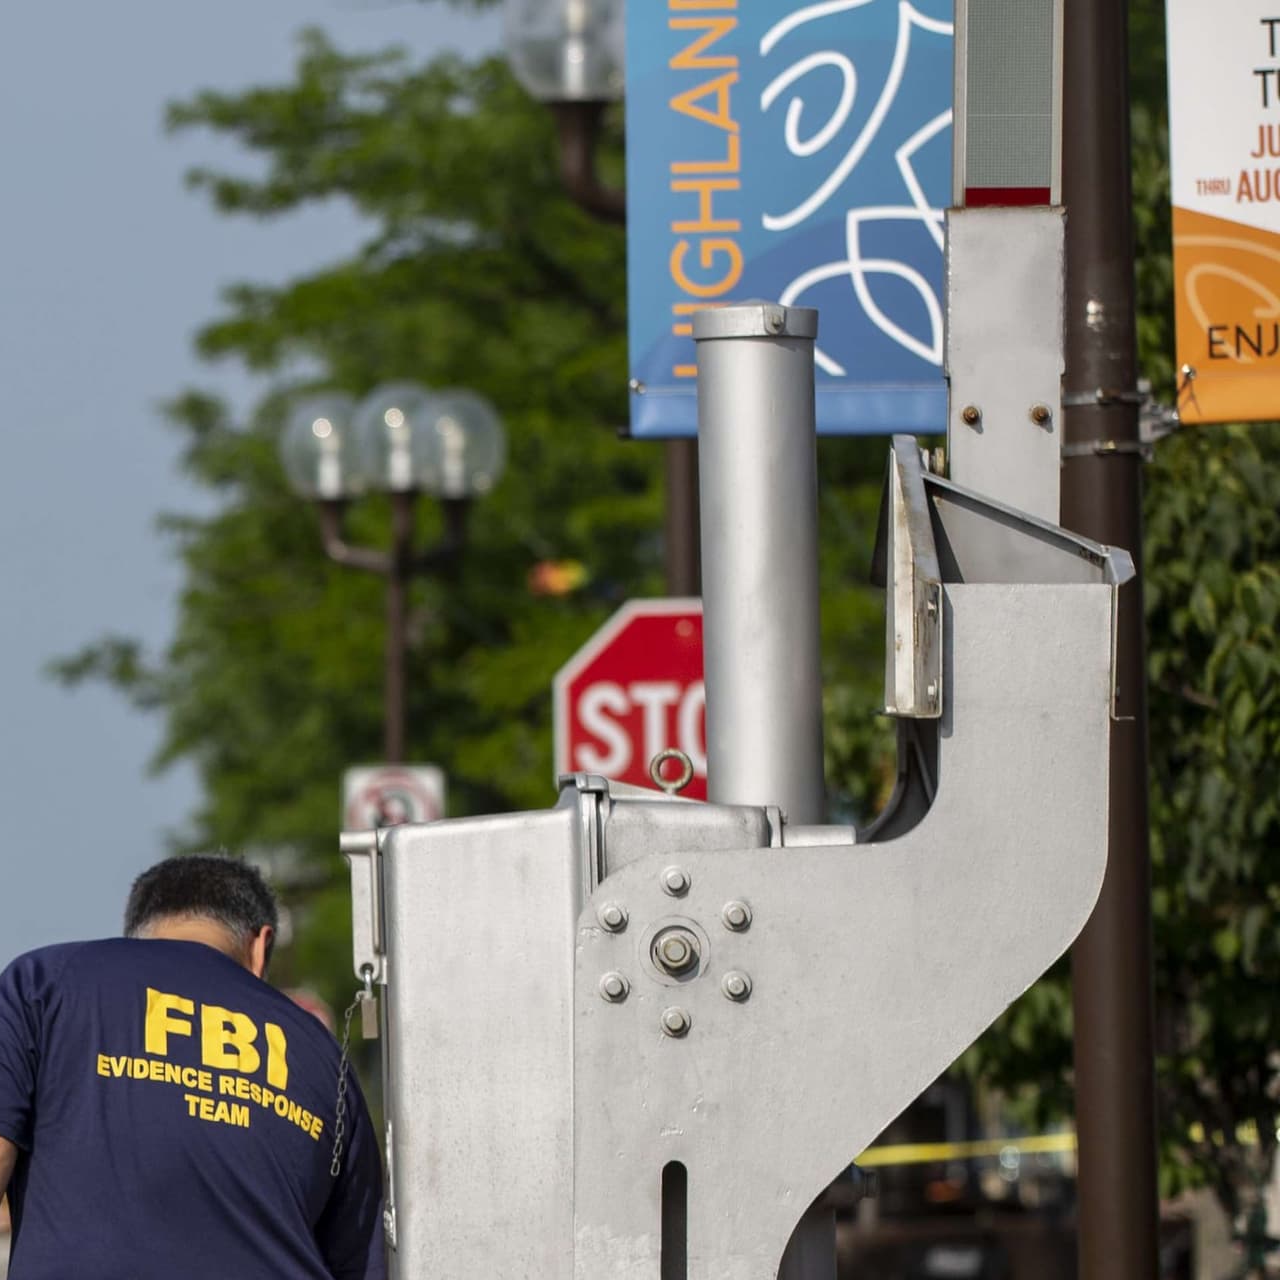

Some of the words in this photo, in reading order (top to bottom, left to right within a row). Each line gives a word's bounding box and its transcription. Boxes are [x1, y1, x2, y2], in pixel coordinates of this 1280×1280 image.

[1252, 67, 1280, 109] T
[669, 0, 743, 378] GHLAN
[1196, 179, 1230, 196] THRU
[1208, 322, 1279, 359] ENJ
[575, 679, 707, 779] STO
[144, 986, 289, 1091] FBI
[96, 1053, 213, 1092] EVIDENCE
[218, 1074, 325, 1141] RESPONSE
[184, 1093, 251, 1128] TEAM
